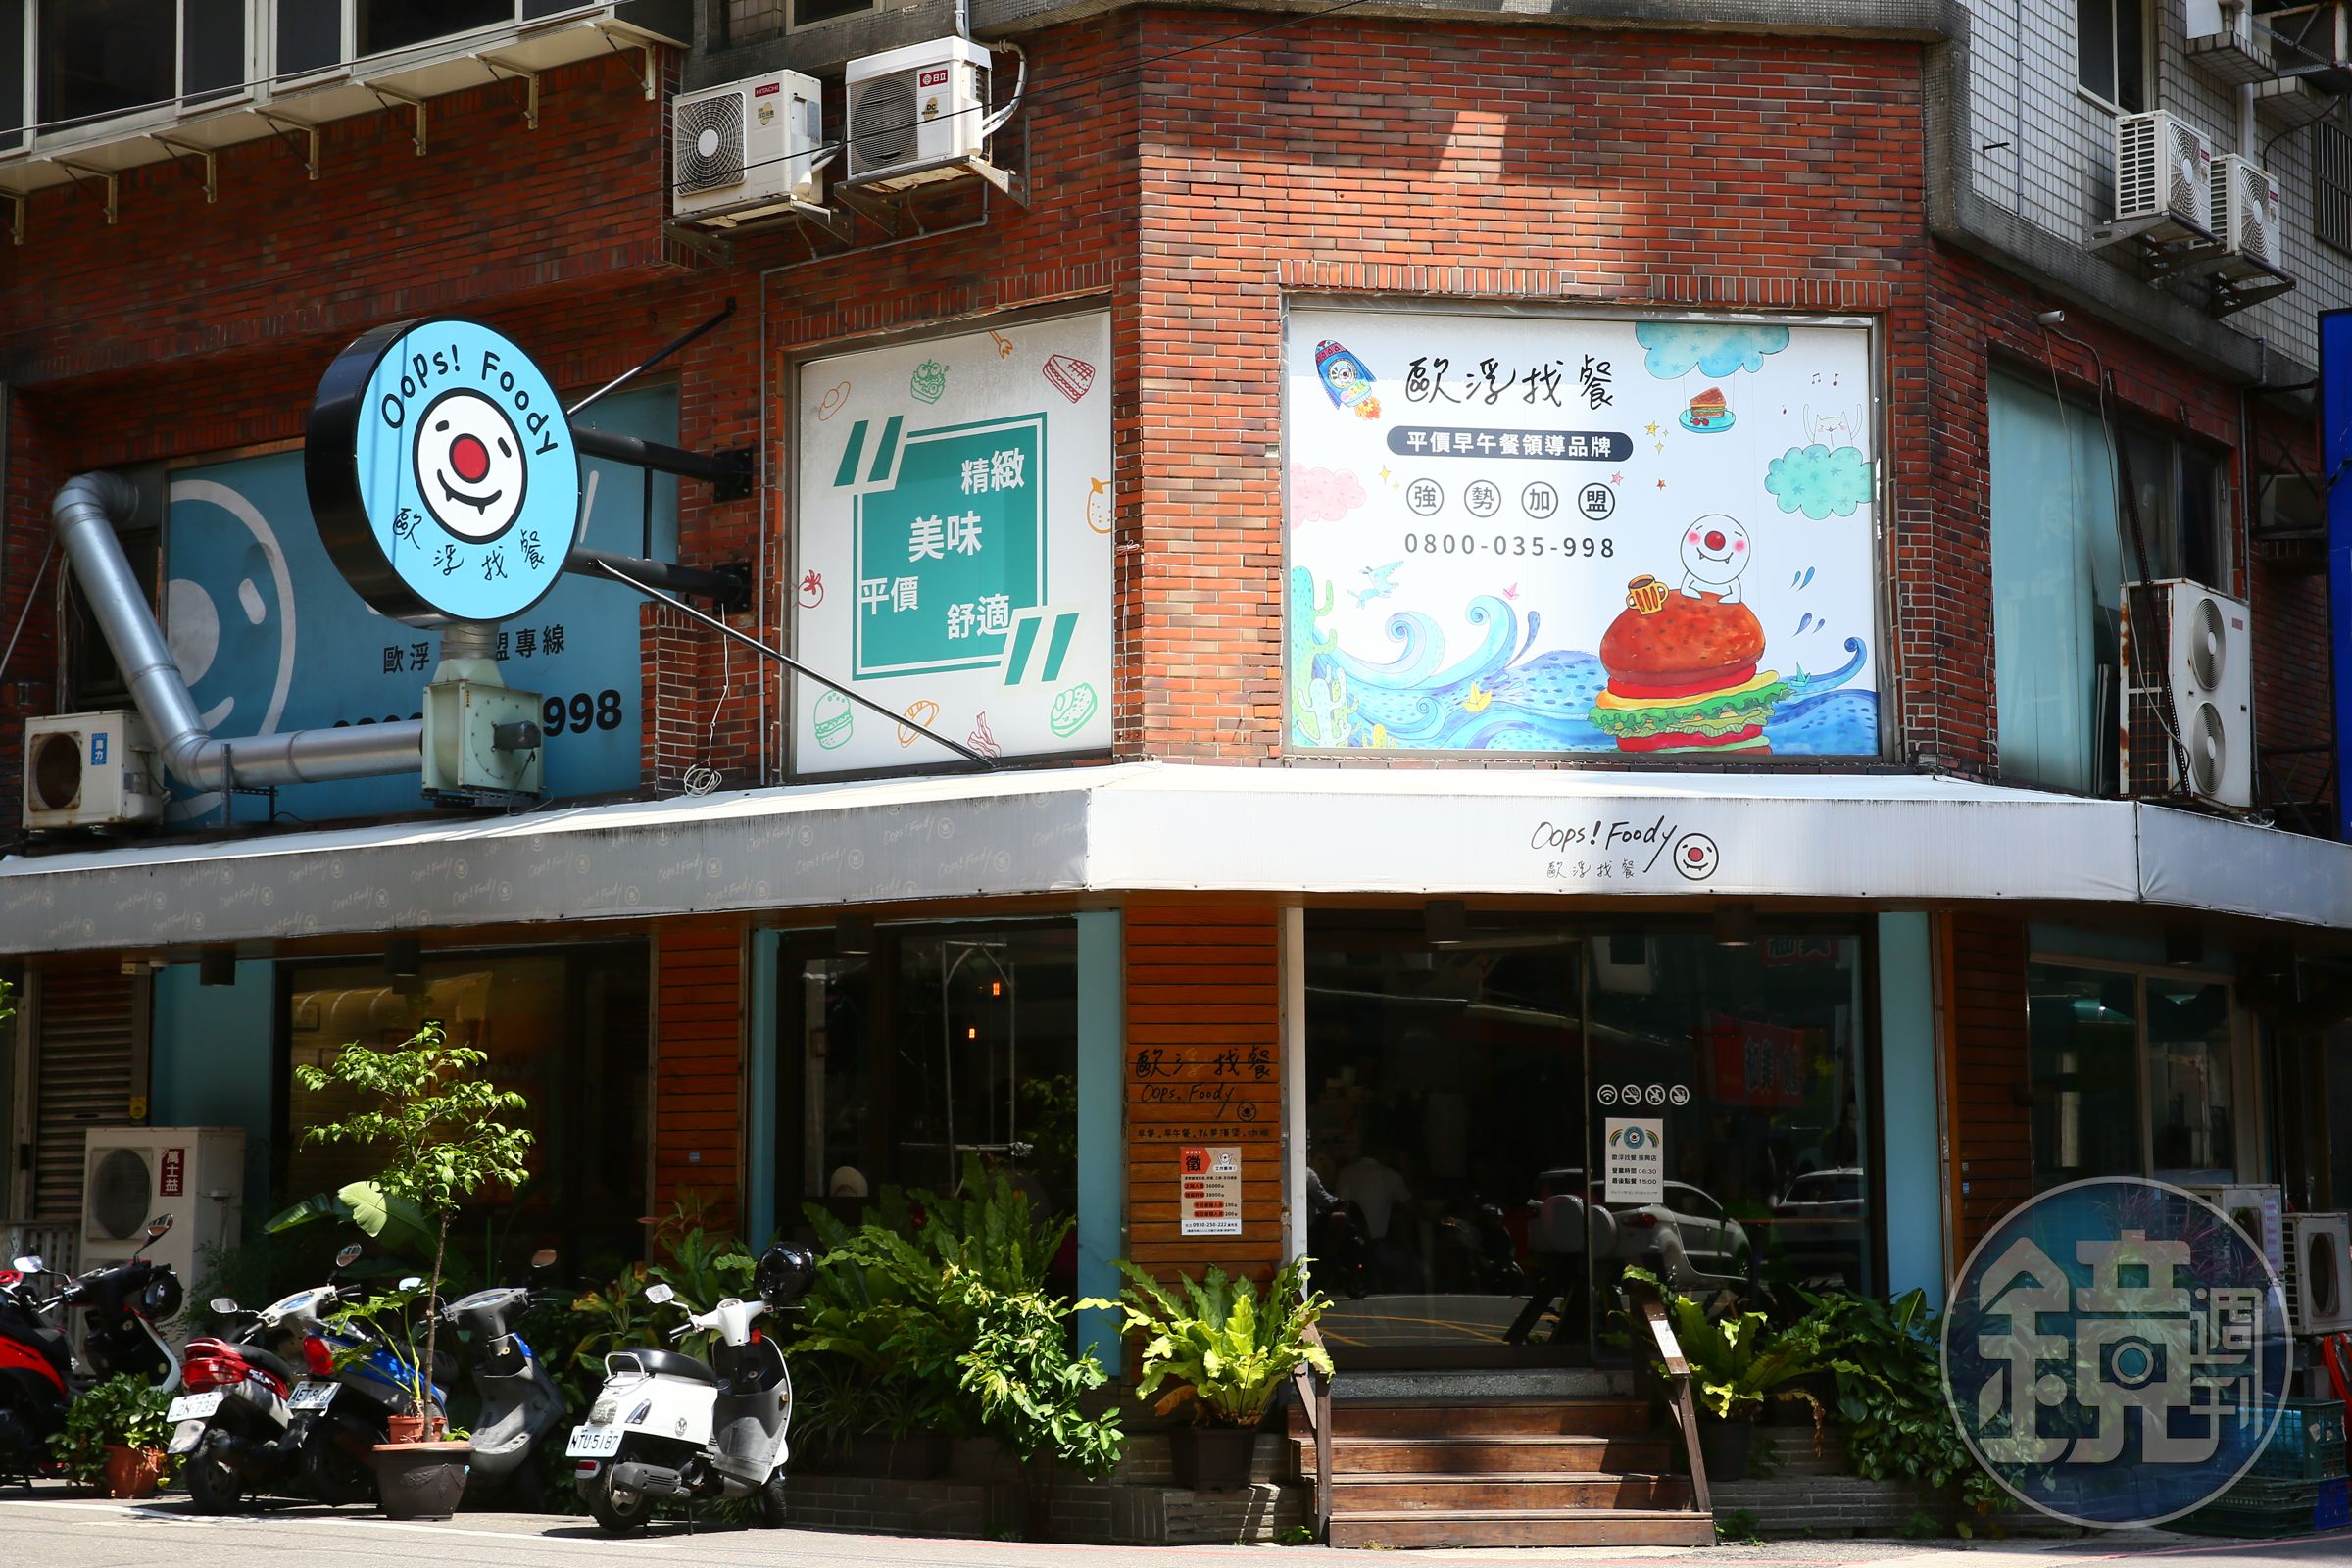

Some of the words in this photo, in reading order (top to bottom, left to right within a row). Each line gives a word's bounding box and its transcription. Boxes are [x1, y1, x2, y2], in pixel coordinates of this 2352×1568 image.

[756, 84, 779, 96] HITACHI
[382, 345, 460, 428] Oops!
[481, 350, 559, 456] Foody
[1405, 354, 1613, 410] 歐浮找餐
[1406, 430, 1612, 458] 平價早午餐領導品牌
[961, 447, 1025, 496] 精緻
[1412, 483, 1609, 516] 強勢加盟
[392, 507, 546, 580] 歐浮找餐
[908, 509, 983, 563] 美味
[1404, 533, 1614, 558] 0800-035-998
[860, 575, 919, 615] 平價
[946, 593, 1010, 640] 舒適
[1531, 820, 1602, 852] Oops!
[1605, 815, 1677, 873] Foody
[1546, 858, 1635, 879] 歐浮找餐
[1189, 1082, 1234, 1119] Foody
[165, 1151, 179, 1192] 萬士益
[1186, 1155, 1201, 1172] 徵
